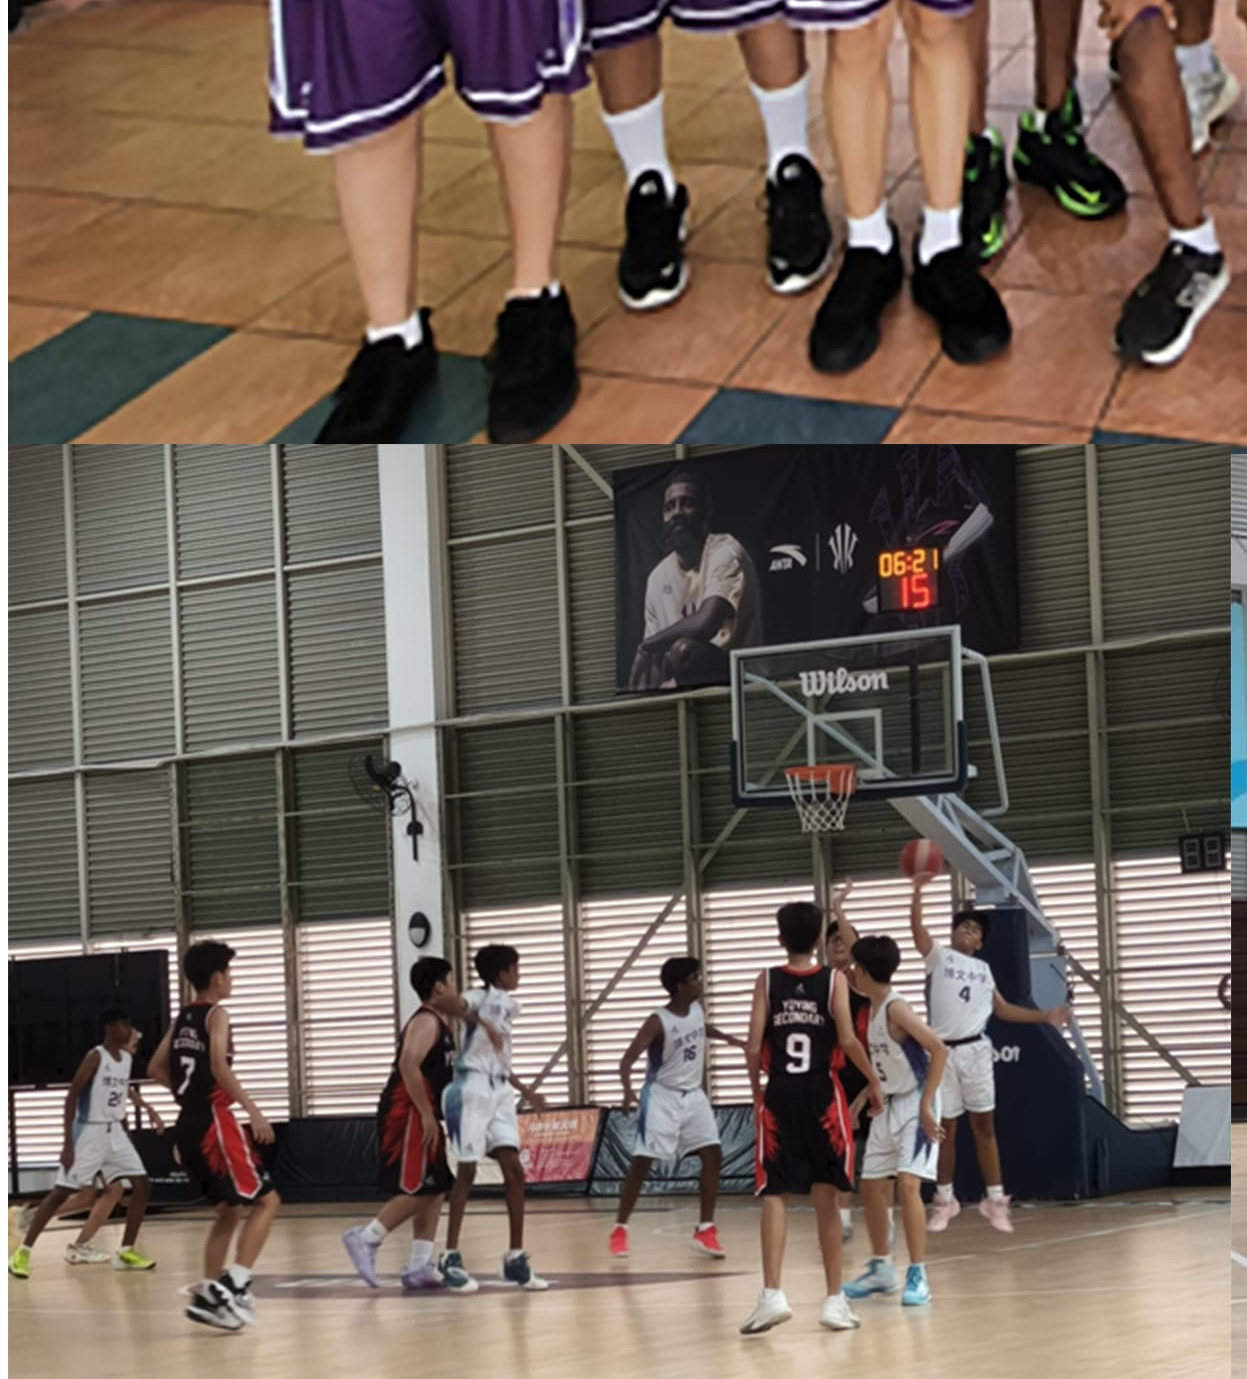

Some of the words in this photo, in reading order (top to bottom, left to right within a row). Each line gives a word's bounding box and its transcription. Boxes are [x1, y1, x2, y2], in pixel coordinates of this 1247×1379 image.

[878, 548, 939, 577] 06:21
[902, 573, 931, 608] 15
[799, 667, 889, 697] Wilson
[959, 986, 971, 1003] 4
[786, 1033, 811, 1073] 9
[178, 1055, 196, 1095] 7
